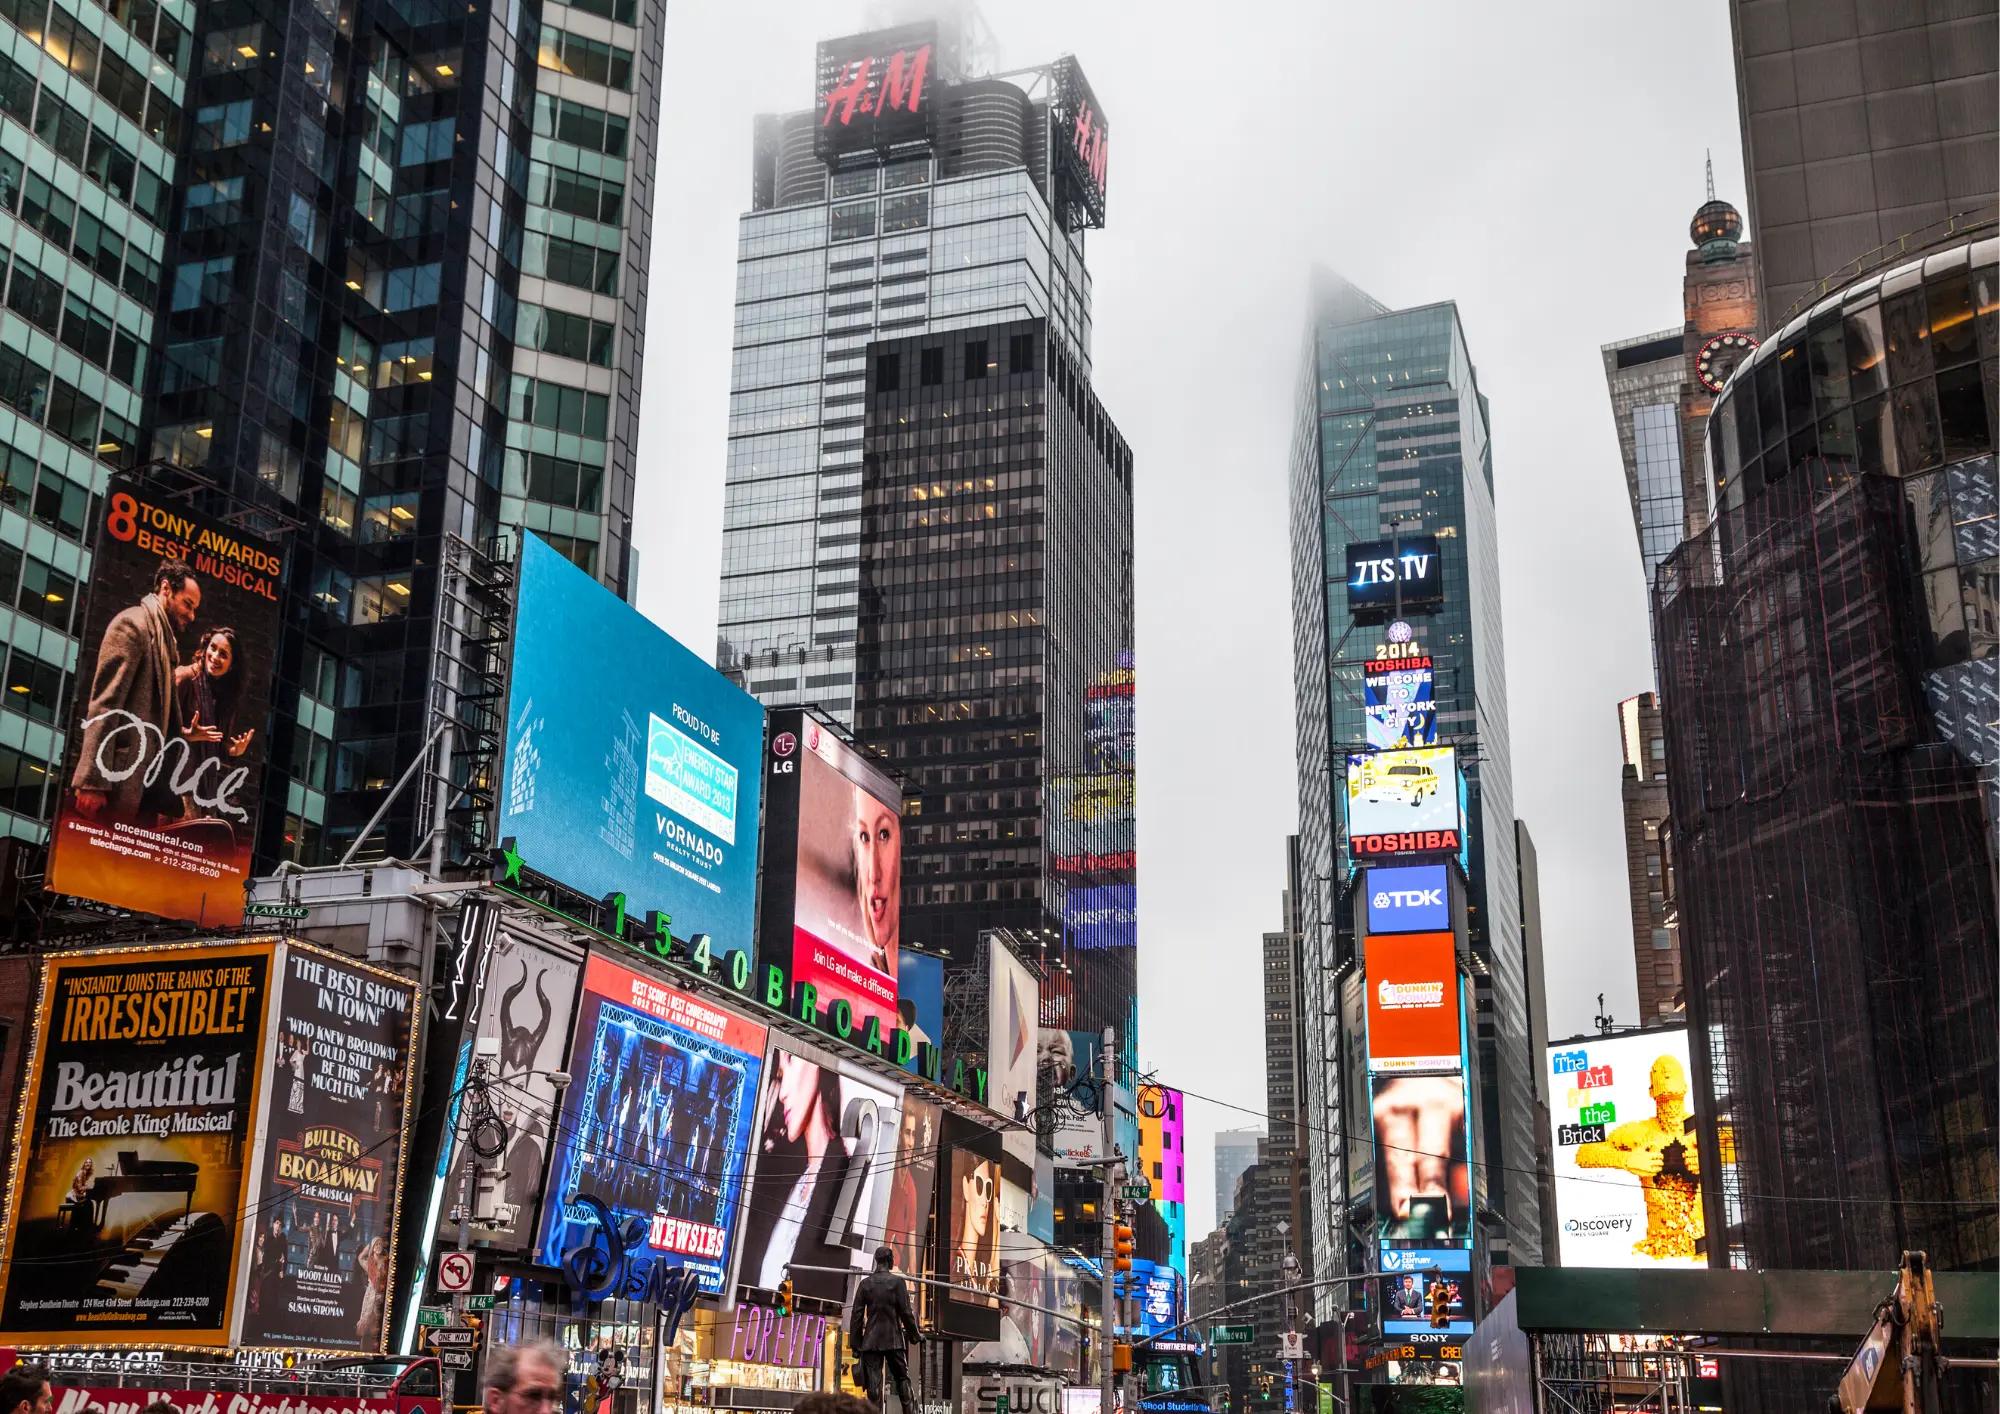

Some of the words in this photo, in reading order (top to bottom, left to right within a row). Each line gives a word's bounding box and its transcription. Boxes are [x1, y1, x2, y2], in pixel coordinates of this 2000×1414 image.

[823, 44, 931, 127] H&M
[1074, 100, 1108, 193] H&M
[107, 492, 138, 542] 8
[140, 502, 196, 540] TONY
[198, 529, 281, 576] AWARDS
[137, 529, 191, 561] BEST
[195, 553, 278, 601] MUSICAL
[1376, 642, 1419, 659] 2014
[1365, 656, 1432, 673] TOSHIBA
[1365, 672, 1432, 687] WELCOME
[1391, 689, 1408, 699] TO
[1365, 703, 1395, 716] NEW
[1398, 700, 1436, 713] YORK
[673, 702, 699, 732] PROUD
[699, 721, 710, 738] TO
[710, 729, 720, 746] BE
[1385, 716, 1416, 728] CITY
[684, 745, 714, 777] ENERGY
[715, 766, 735, 791] STAR
[773, 761, 793, 774] LG
[682, 771, 711, 799] AWARD
[712, 790, 732, 813] 2013
[76, 824, 103, 837] bernard
[112, 833, 135, 846] jacobs
[114, 822, 204, 853] oncemusical.com
[656, 813, 723, 866] VORNADO
[1351, 831, 1458, 853] TOSHIBA
[90, 837, 151, 860] telecharge.com
[162, 855, 220, 878] 212-239-6200
[666, 841, 690, 859] REALTY
[692, 854, 712, 871] TRUST
[1389, 889, 1443, 907] TDK
[252, 906, 303, 916] LAMAR
[612, 892, 748, 990] 1540
[123, 972, 154, 994] JOINS
[156, 971, 176, 990] THE
[177, 969, 214, 990] RANKS
[216, 968, 231, 986] OF
[232, 966, 252, 986] THE
[813, 948, 826, 967] Join
[827, 954, 835, 971] LG
[835, 962, 847, 977] and
[847, 969, 862, 986] make
[863, 979, 867, 988] a
[868, 978, 894, 1001] difference
[317, 988, 334, 1012] IN
[327, 968, 363, 998] BEST
[365, 982, 408, 1013] SHOW
[632, 979, 648, 997] BEST
[648, 986, 667, 1004] SCORE
[671, 995, 686, 1013] BEST
[632, 995, 649, 1010] 2012
[652, 1002, 670, 1018] TONY
[671, 1011, 695, 1028] AWARD
[316, 1026, 345, 1046] KNEW
[347, 1035, 399, 1062] BROADWAY
[767, 964, 988, 1104] BROADWAY
[312, 1042, 346, 1062] COULD
[348, 1052, 373, 1071] STILL
[1555, 1056, 1585, 1072] The
[51, 1052, 240, 1111] Beautiful
[322, 1060, 333, 1075] BE
[336, 1064, 360, 1083] THIS
[1584, 1071, 1608, 1087] Art
[311, 1074, 341, 1095] MUCH
[49, 1116, 78, 1138] The
[80, 1114, 130, 1135] Carole
[132, 1112, 170, 1138] King
[171, 1110, 234, 1133] Musical
[1585, 1107, 1610, 1124] the
[304, 1129, 360, 1158] BULLETS
[1562, 1127, 1601, 1144] Brick
[320, 1148, 343, 1162] OVER
[279, 1153, 379, 1194] BROADWAY
[301, 1183, 318, 1197] THE
[317, 1186, 353, 1203] MUSICAL
[1124, 1188, 1129, 1197] W
[1131, 1187, 1140, 1198] 46
[649, 1215, 726, 1258] NEWSIES
[1567, 1219, 1632, 1232] Discovery
[298, 1269, 322, 1281] WOODY
[322, 1273, 342, 1284] ALLEN
[956, 1256, 992, 1277] PRADA
[288, 1302, 311, 1313] SUSAN
[313, 1305, 344, 1317] STROMAN
[471, 1299, 477, 1308] W
[478, 1299, 486, 1308] 46
[420, 1310, 438, 1324] TIMES
[438, 1333, 452, 1342] ONE
[455, 1333, 470, 1342] WAY
[730, 1304, 826, 1368] FOREVER
[1411, 1334, 1448, 1342] SONY
[235, 1351, 284, 1372] GIFTS
[446, 1354, 457, 1362] ONE
